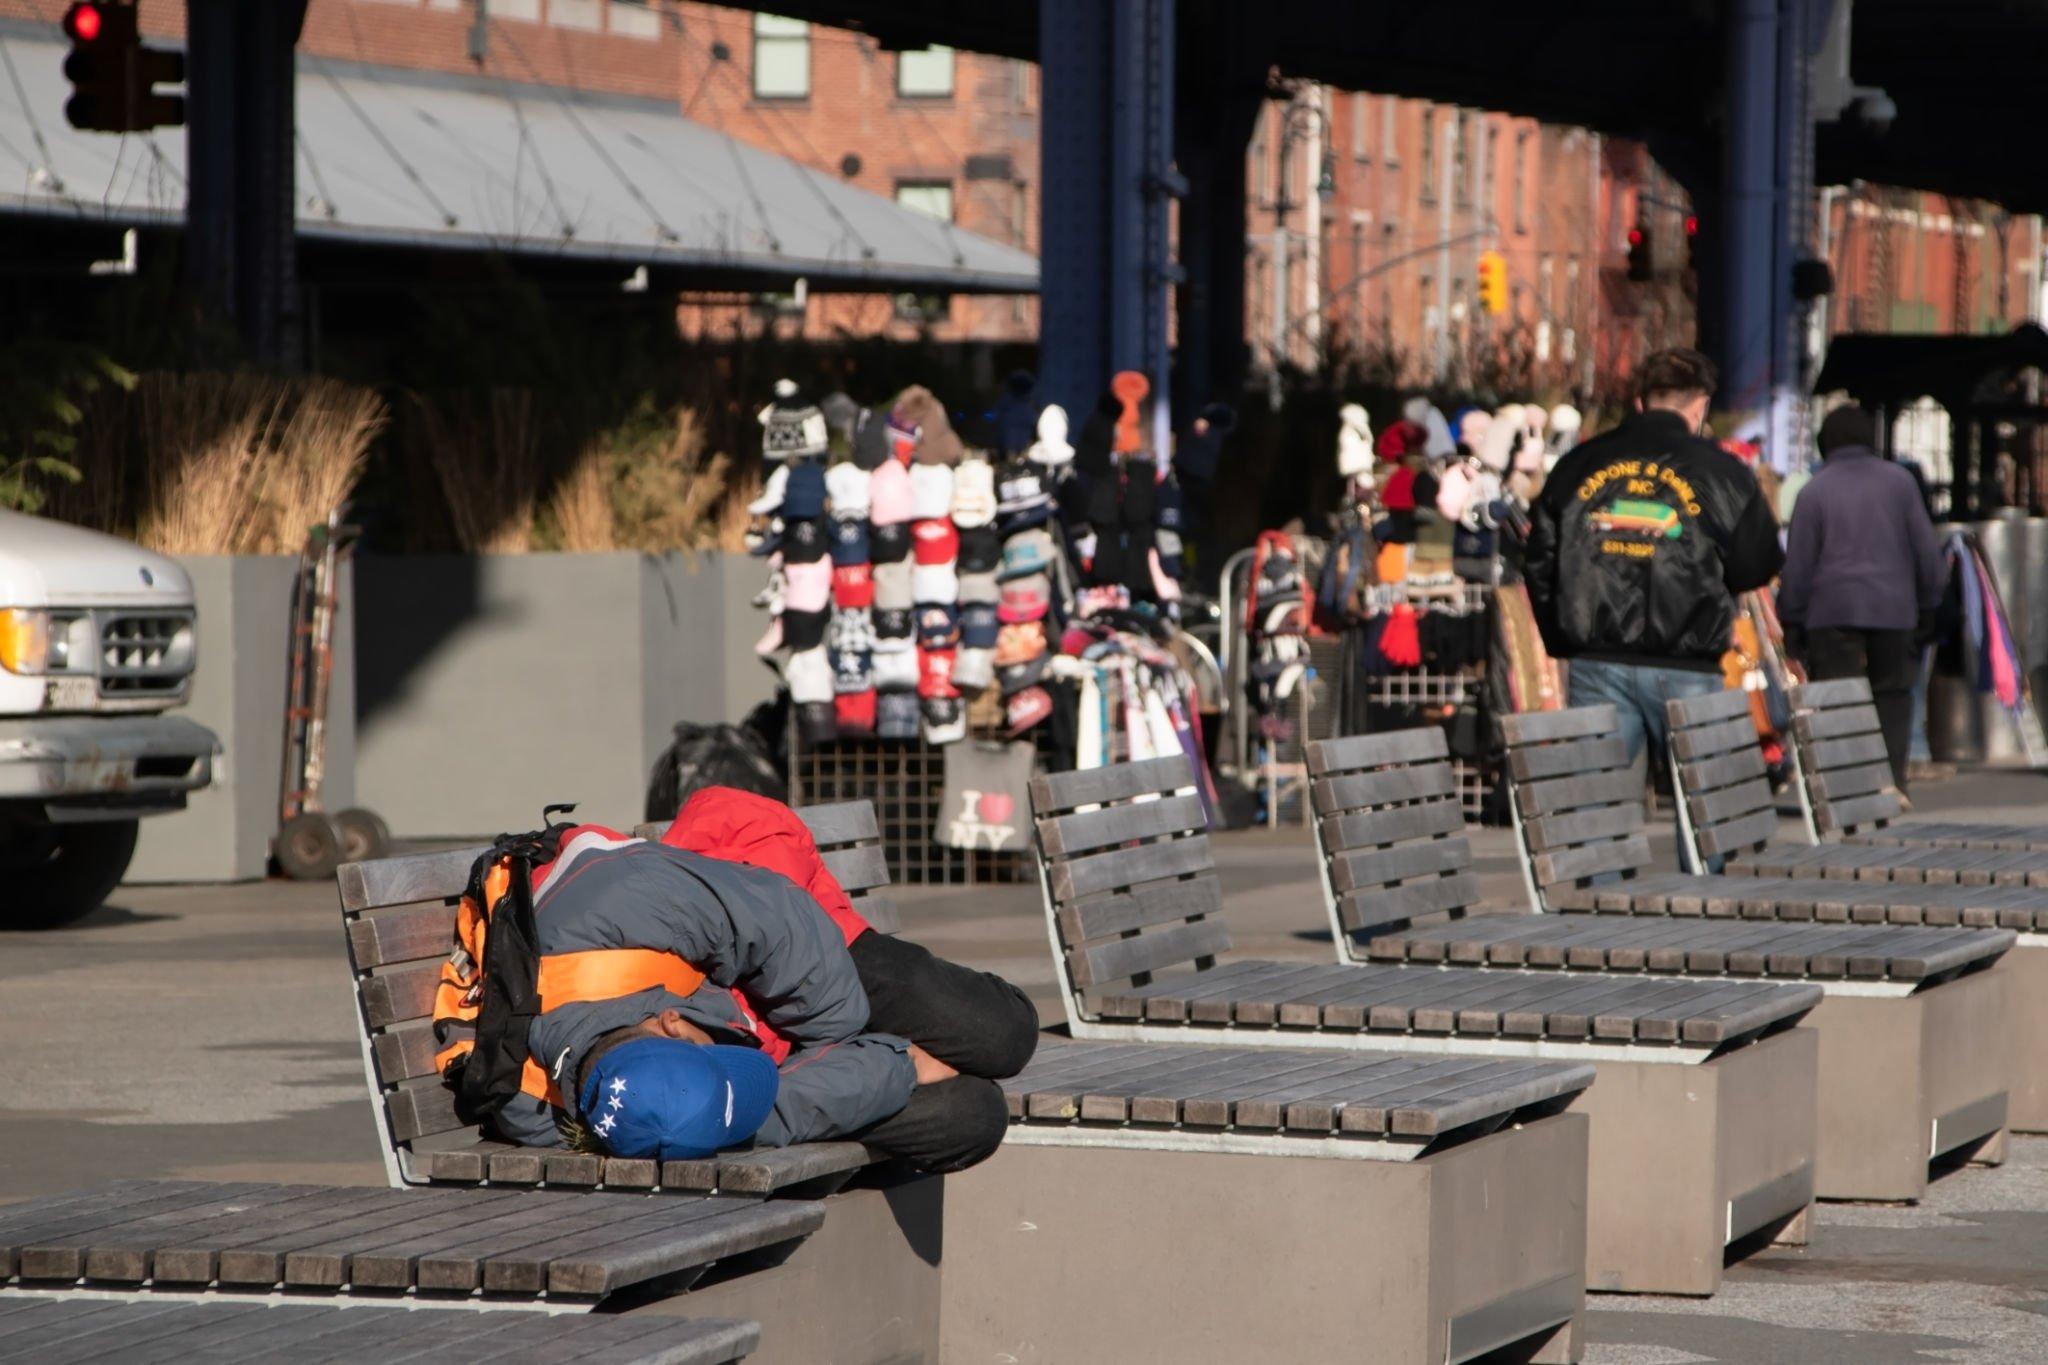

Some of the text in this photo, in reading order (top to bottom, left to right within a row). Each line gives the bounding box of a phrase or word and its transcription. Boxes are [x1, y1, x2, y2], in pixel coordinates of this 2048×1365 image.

[1578, 460, 1641, 501] CAPONE
[1644, 462, 1658, 478] &
[959, 789, 982, 821] I
[949, 820, 1016, 851] NY
